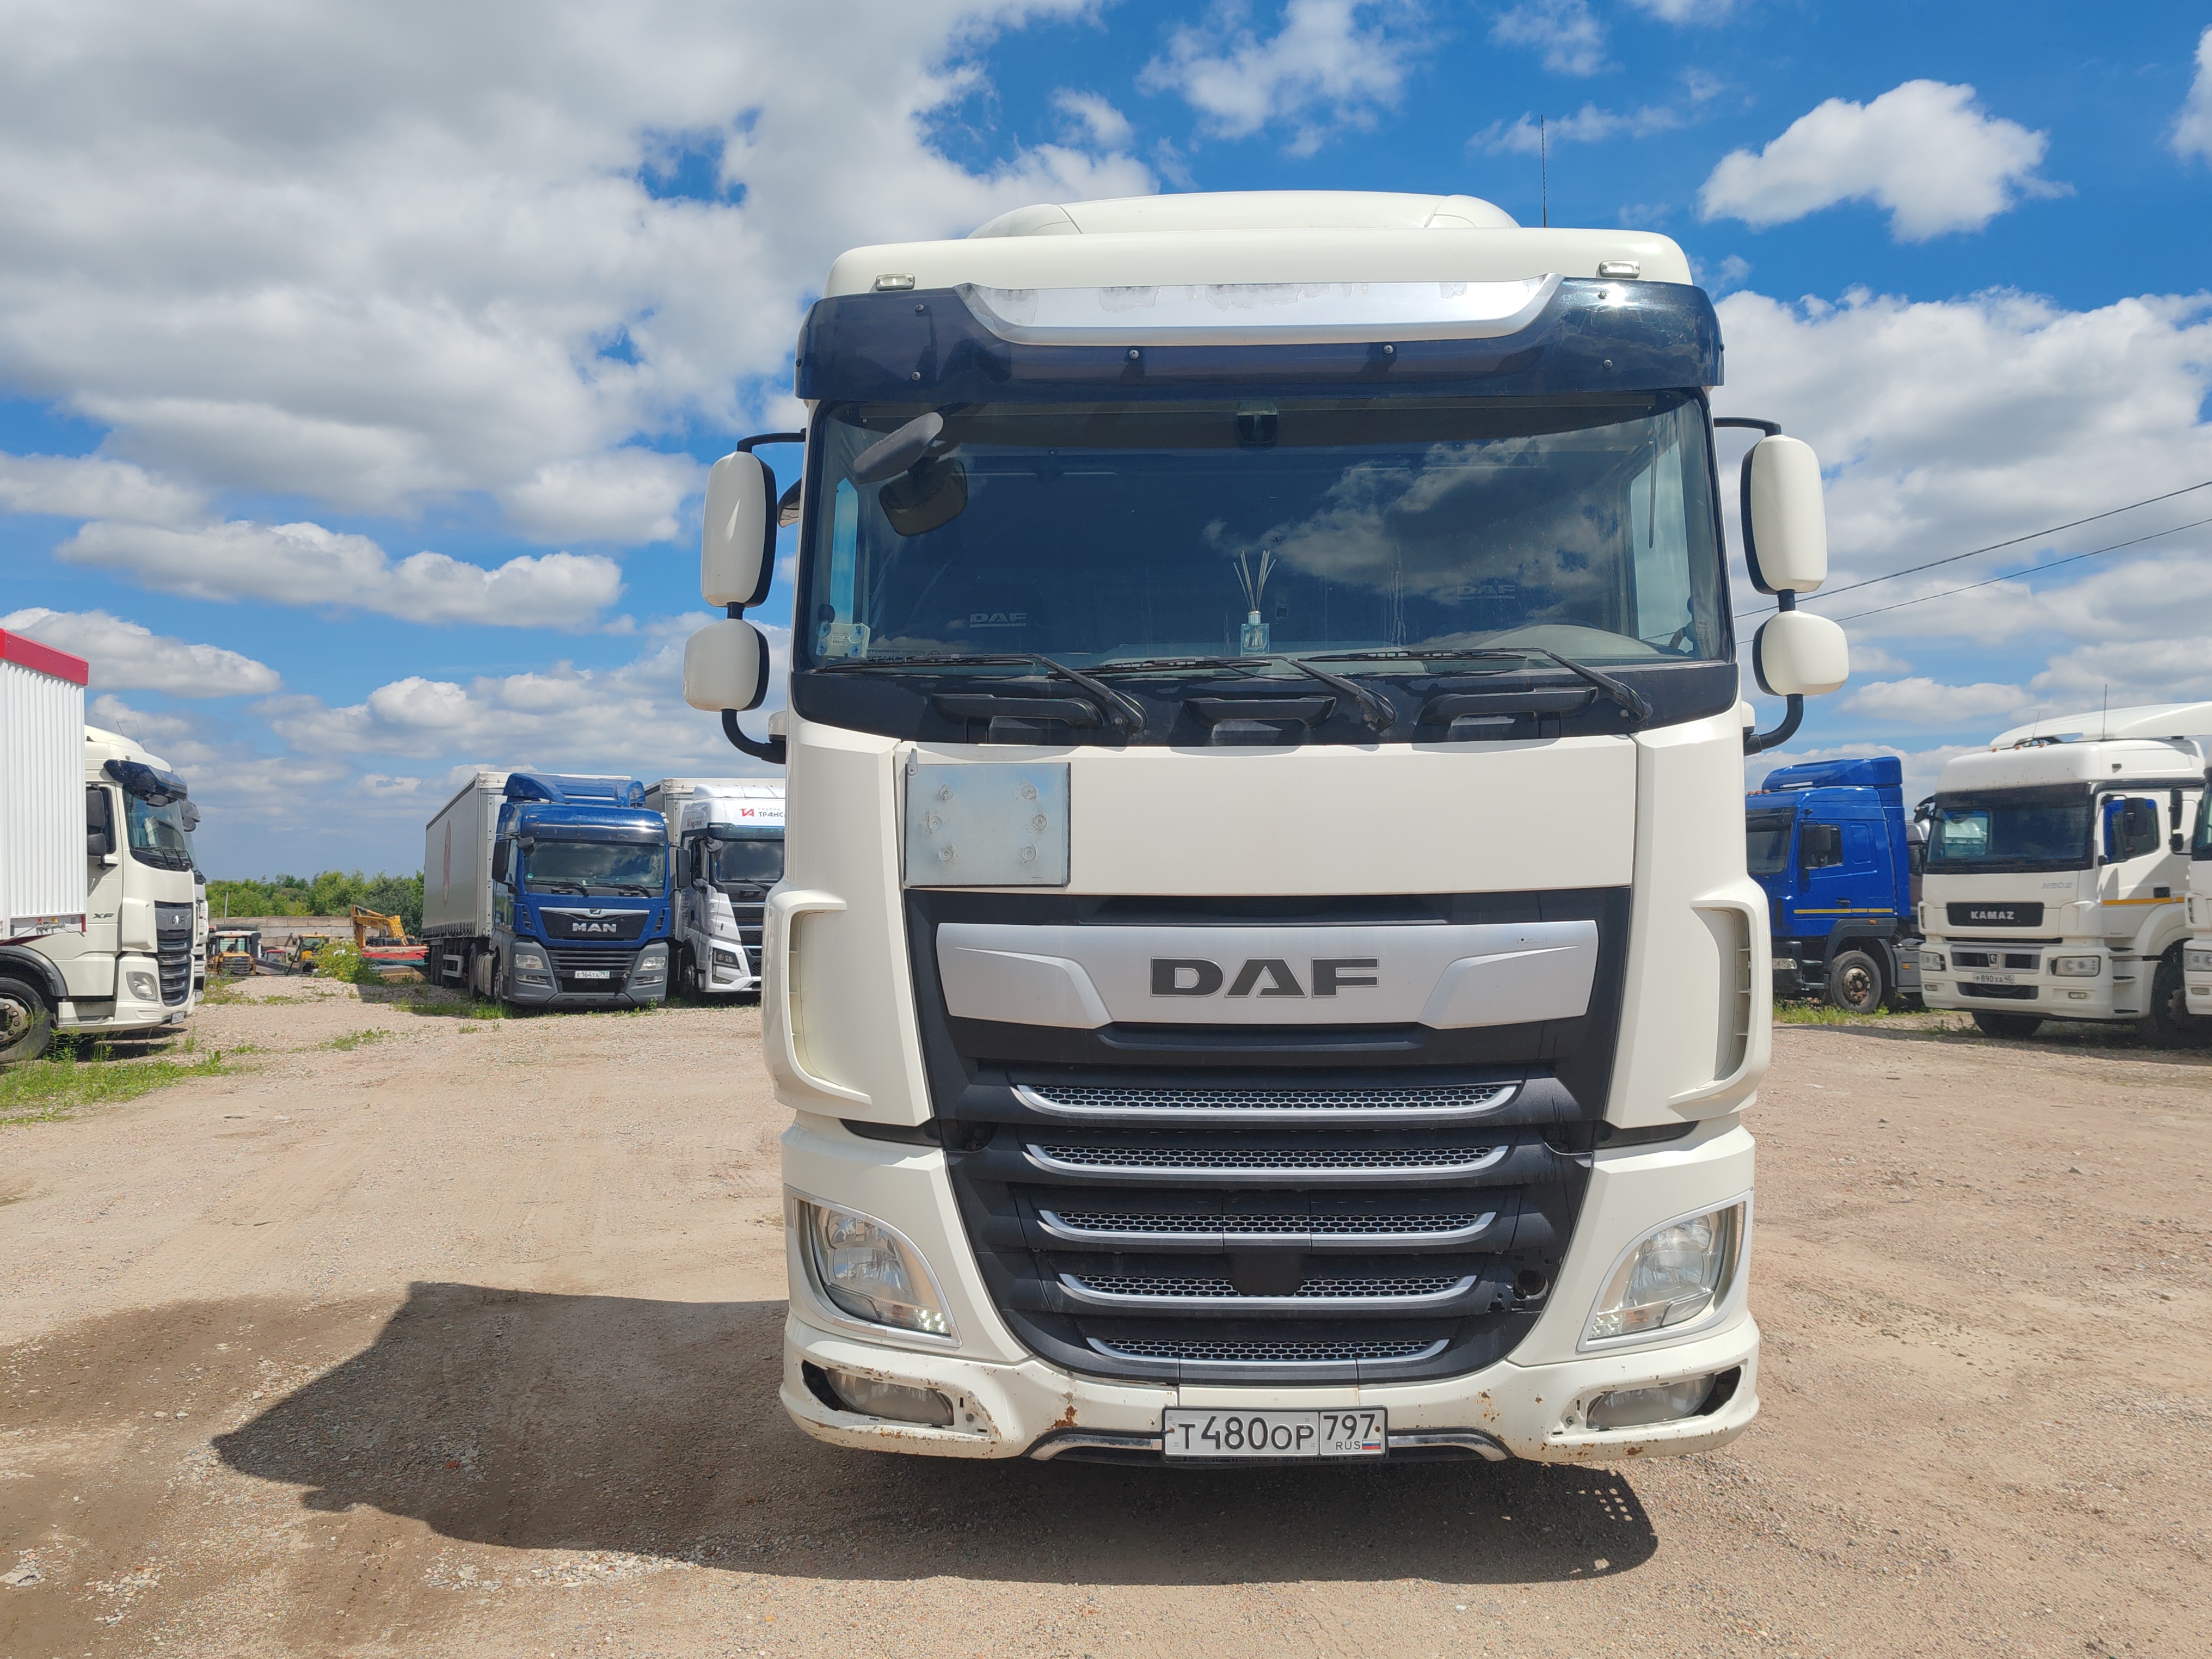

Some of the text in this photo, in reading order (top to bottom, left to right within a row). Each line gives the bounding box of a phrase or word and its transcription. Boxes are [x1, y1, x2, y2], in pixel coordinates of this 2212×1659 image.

[1457, 585, 1515, 595] DAF
[970, 613, 1027, 622] DAF
[1971, 911, 2014, 920] KAMAZ
[572, 923, 617, 932] MAN
[1150, 956, 1379, 998] DAF
[1178, 1414, 1376, 1450] Т480ОР 797
[1336, 1440, 1361, 1450] RUS
